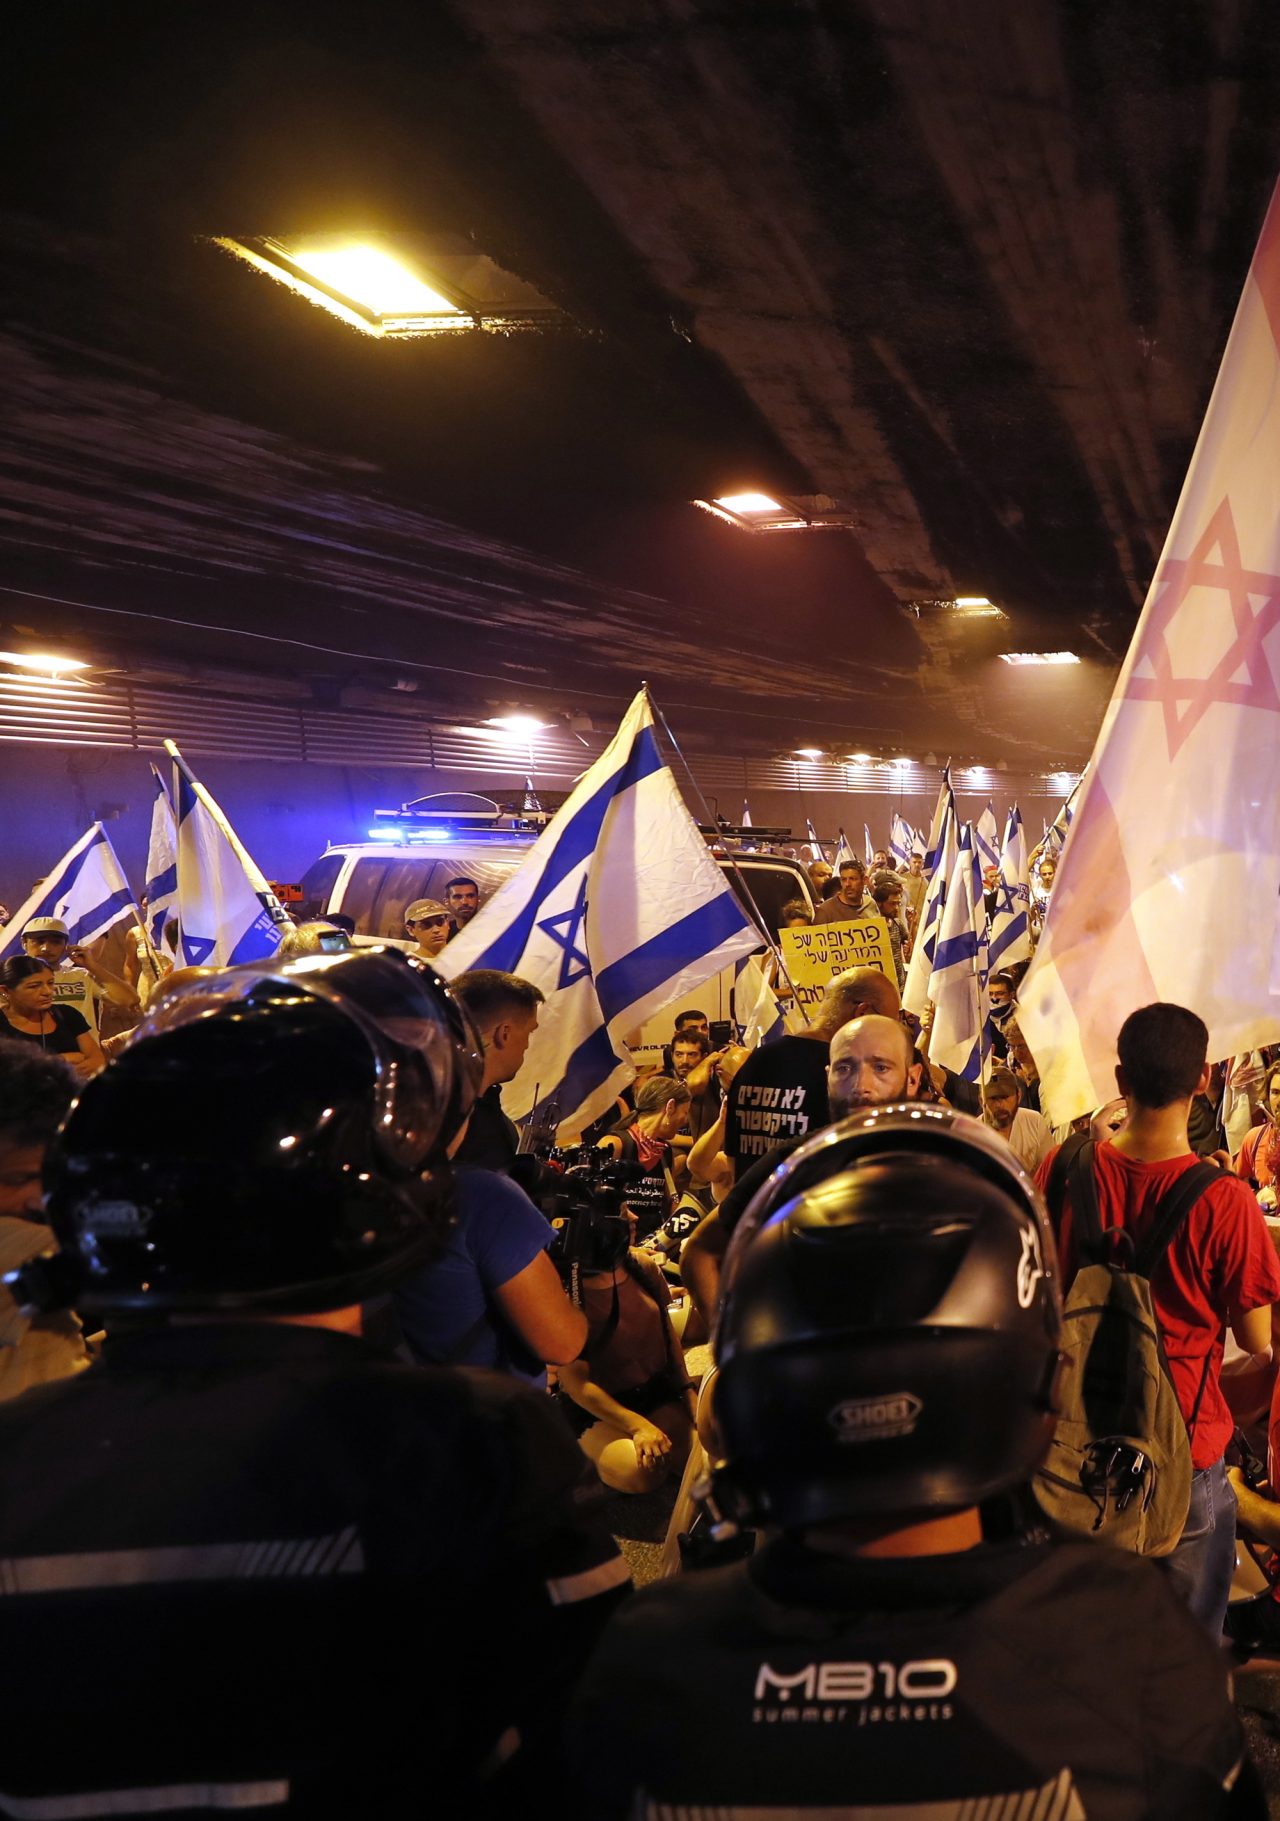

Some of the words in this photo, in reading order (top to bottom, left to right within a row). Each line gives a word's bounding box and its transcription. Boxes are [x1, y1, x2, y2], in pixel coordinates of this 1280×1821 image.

[792, 932, 812, 949] של
[816, 925, 881, 947] פרצופה
[804, 950, 828, 964] שלי
[831, 945, 882, 962] המדינה
[737, 1085, 781, 1108] נסכים
[780, 1085, 806, 1110] לא
[754, 1658, 958, 1701] MB10
[753, 1706, 848, 1723] summer
[858, 1703, 954, 1726] jackets
